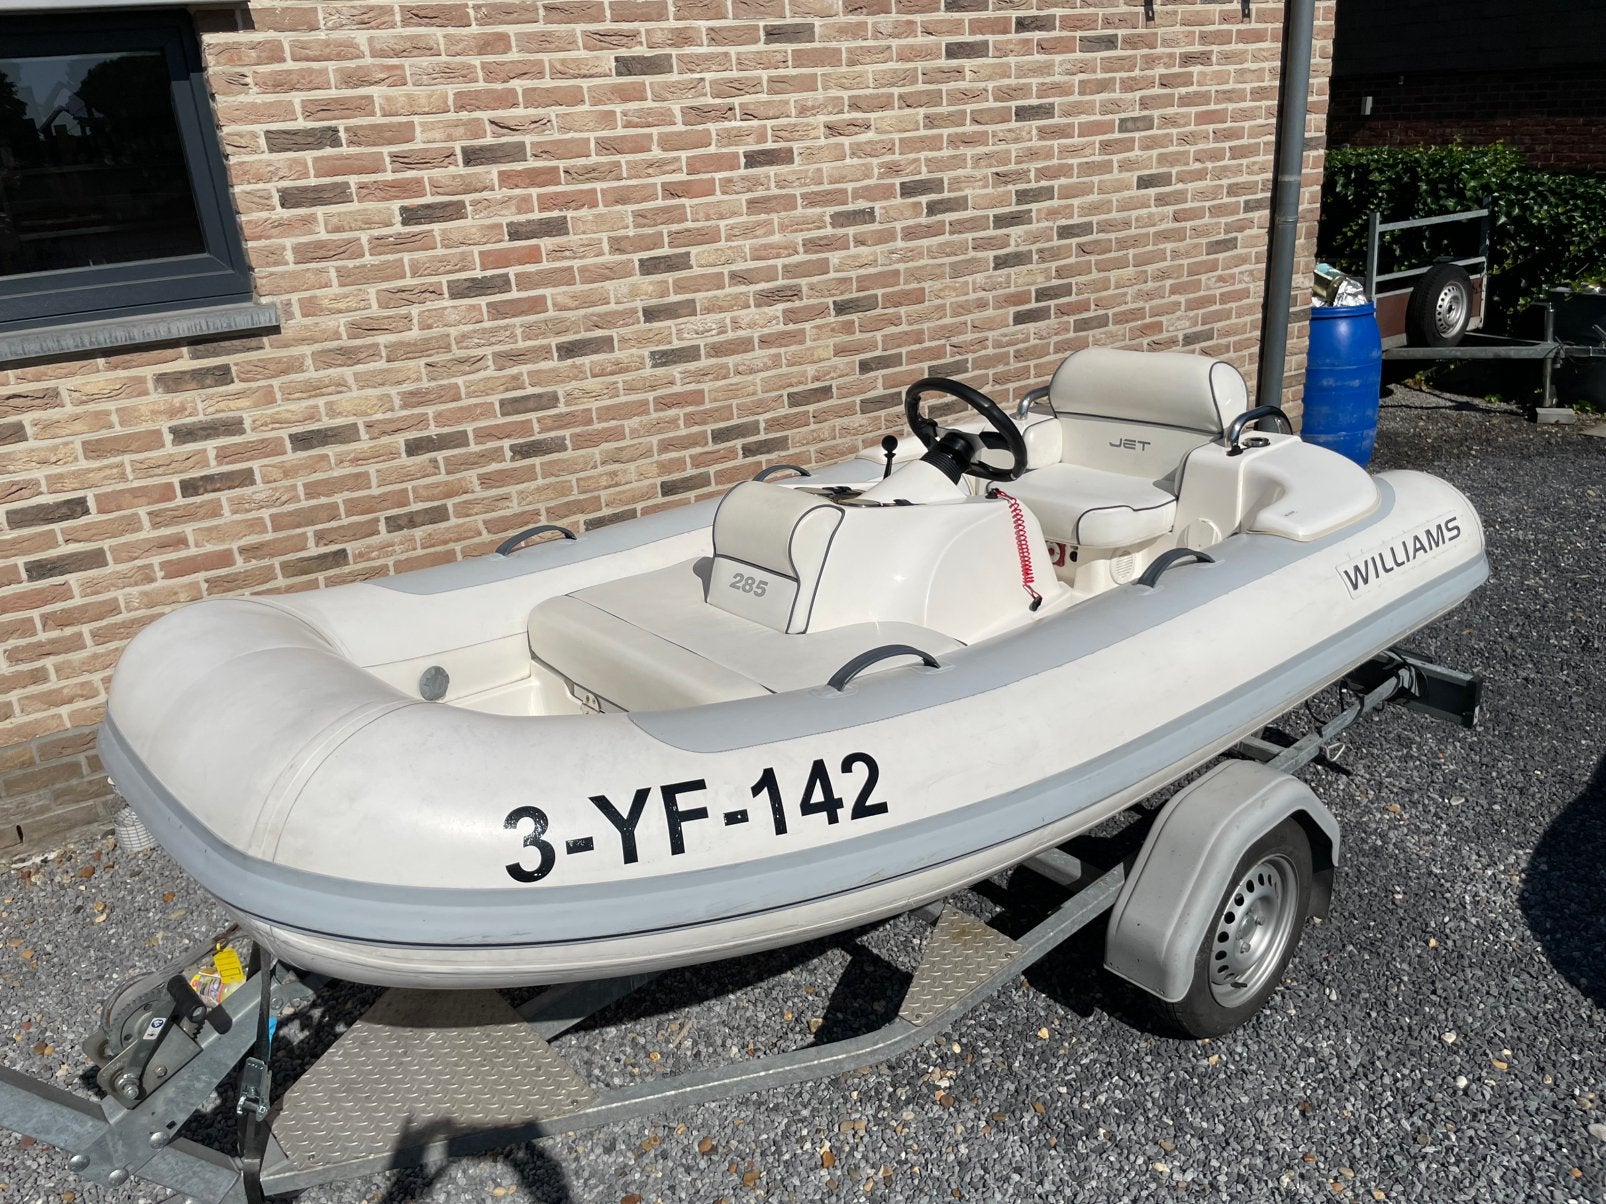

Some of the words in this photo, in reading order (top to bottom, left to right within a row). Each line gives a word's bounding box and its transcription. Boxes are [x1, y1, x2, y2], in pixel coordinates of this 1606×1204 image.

[1109, 438, 1151, 451] JET
[1343, 516, 1461, 591] WILLIAMS
[729, 573, 768, 597] 285
[503, 752, 888, 883] 3-YF-142
